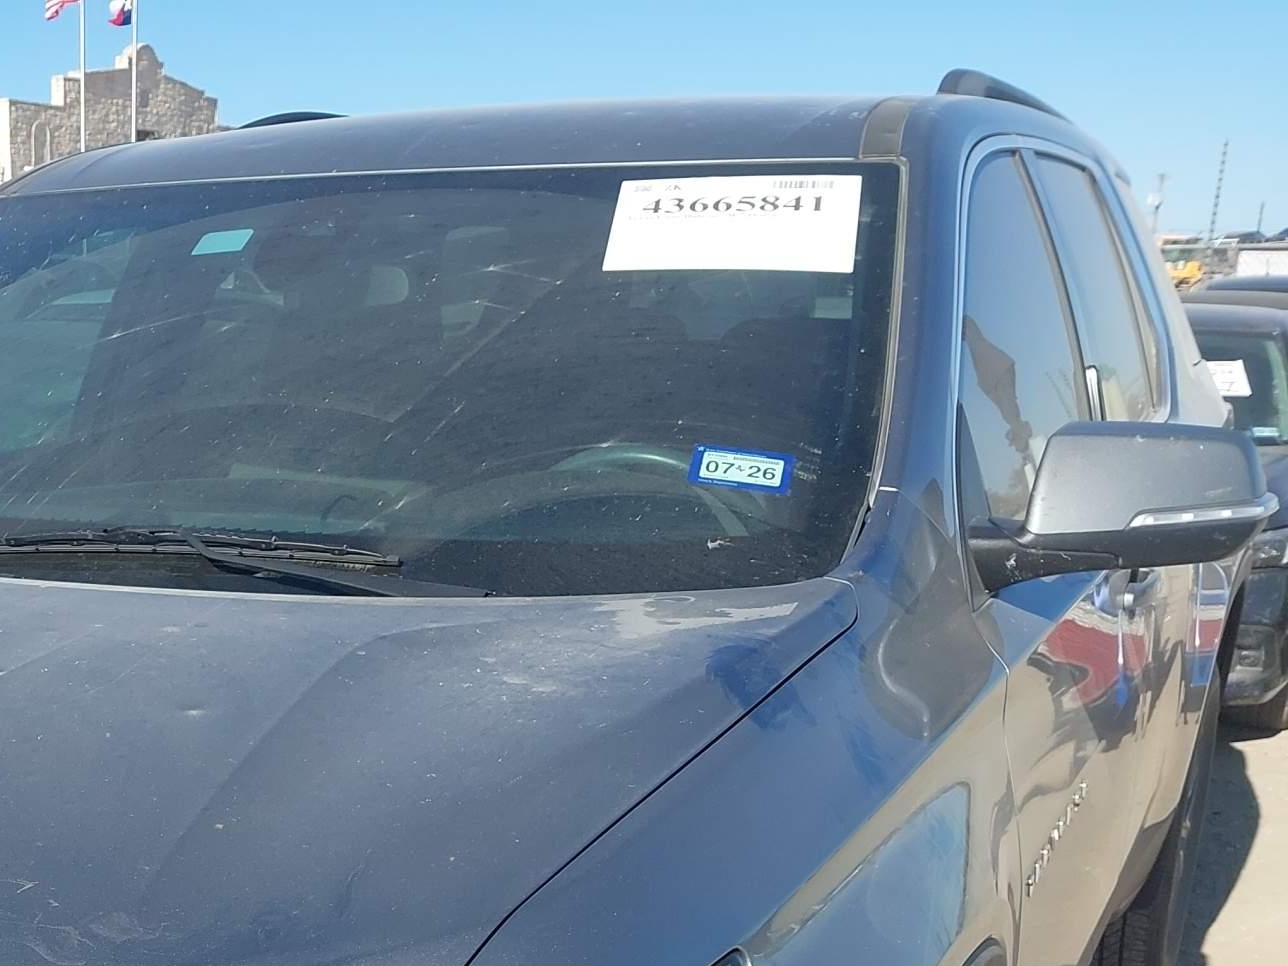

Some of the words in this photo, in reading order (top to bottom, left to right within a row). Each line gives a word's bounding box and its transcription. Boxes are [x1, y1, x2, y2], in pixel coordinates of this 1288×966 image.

[642, 195, 824, 214] 43665841
[705, 460, 736, 475] 07
[746, 465, 777, 480] 26
